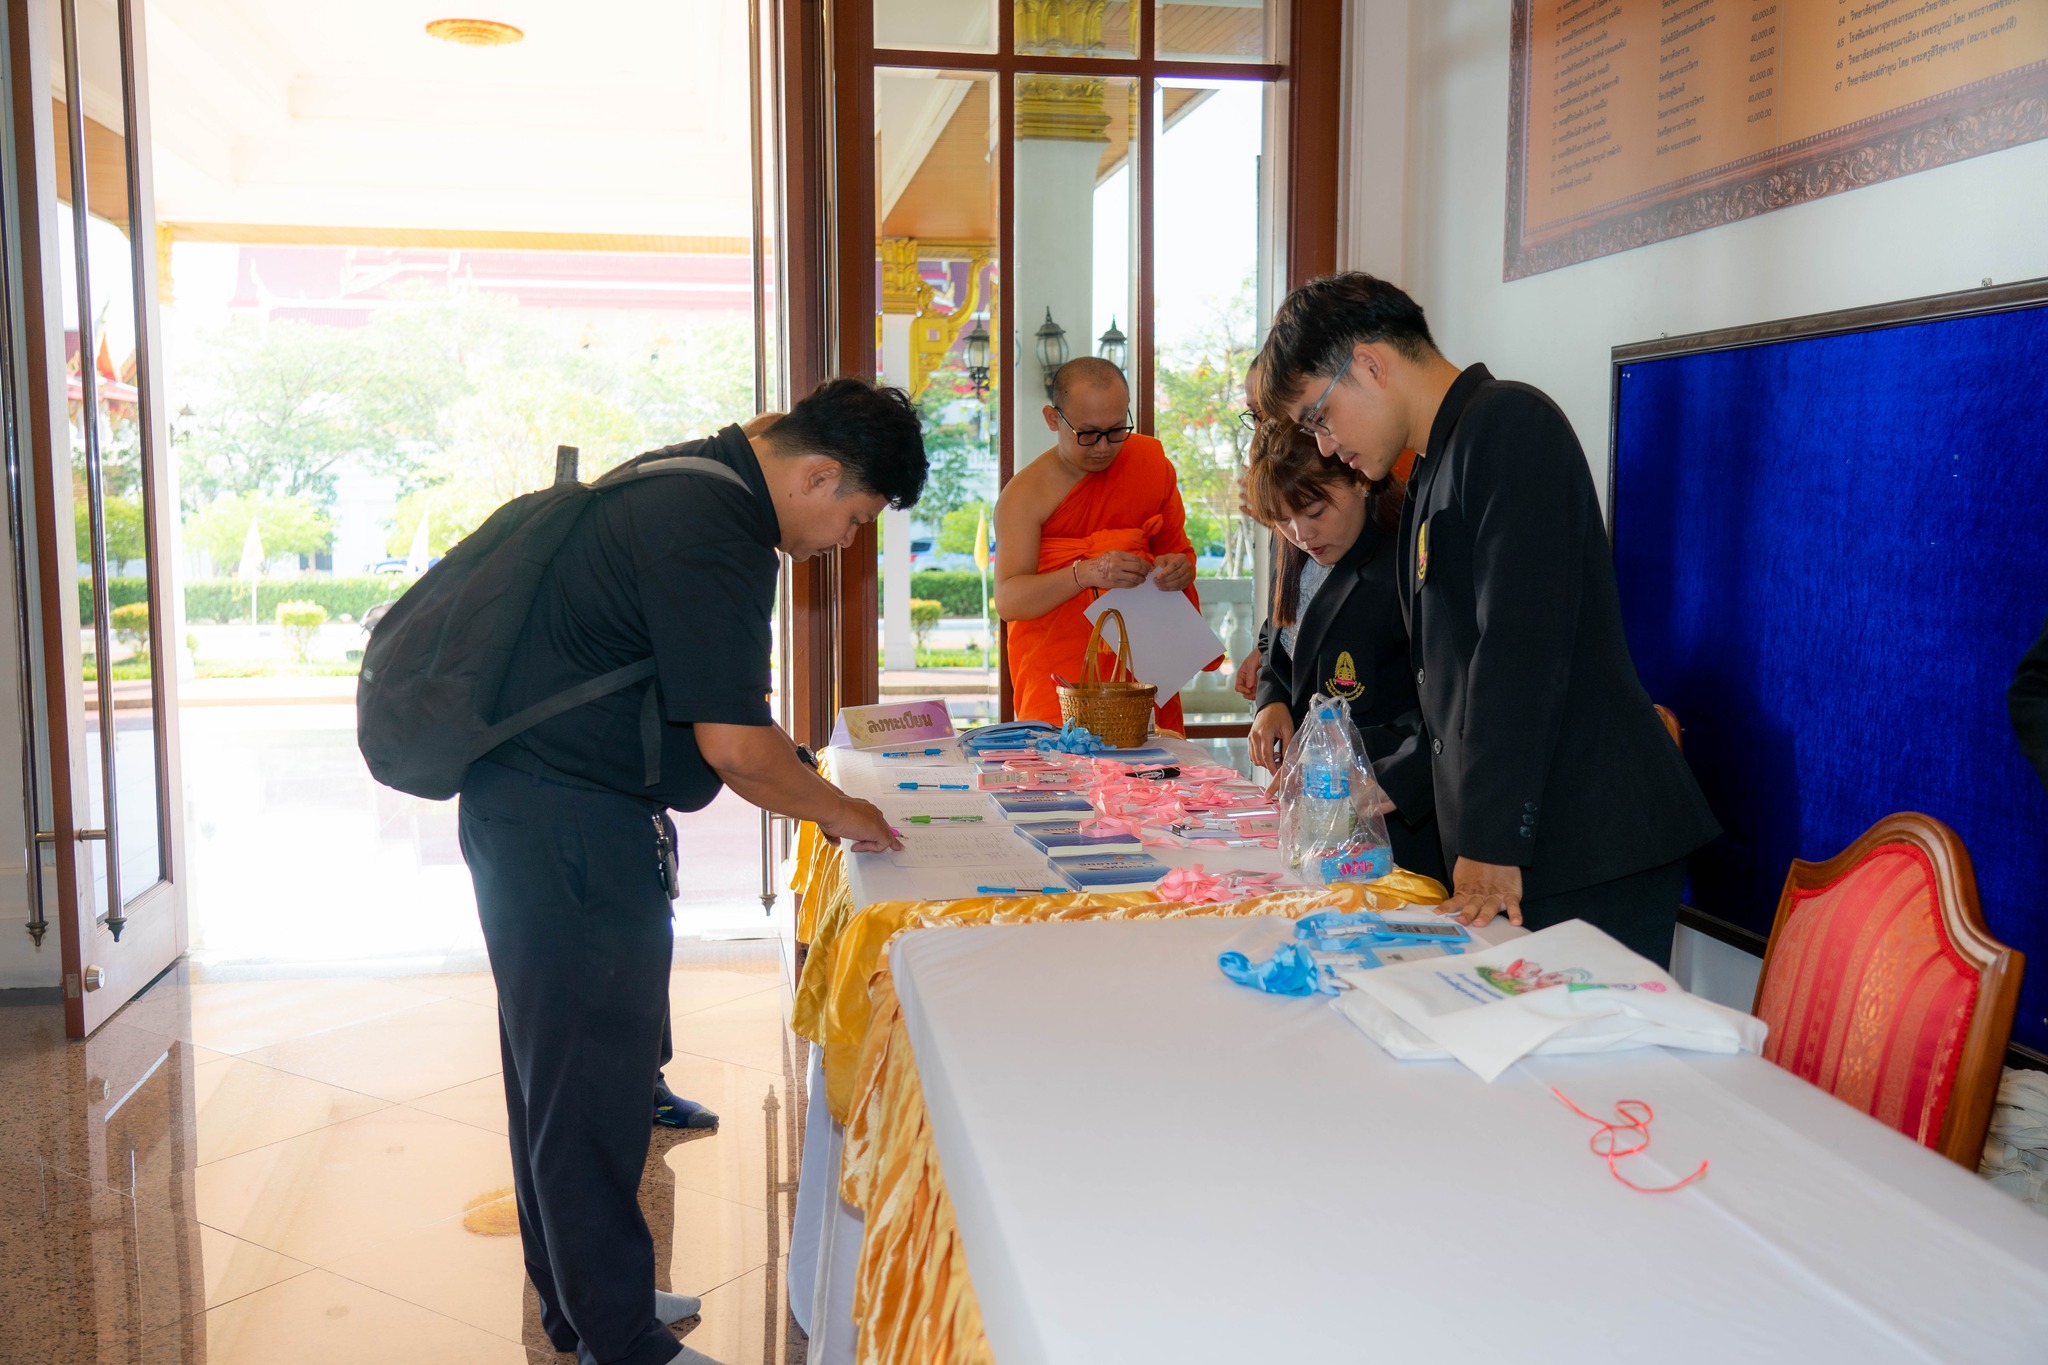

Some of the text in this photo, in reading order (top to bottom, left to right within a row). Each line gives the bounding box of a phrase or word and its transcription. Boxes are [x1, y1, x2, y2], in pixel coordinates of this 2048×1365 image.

[1836, 37, 1845, 49] 65
[1835, 60, 1844, 71] 66
[1834, 81, 1843, 92] 67
[866, 711, 934, 733] ลงทะเบียน
